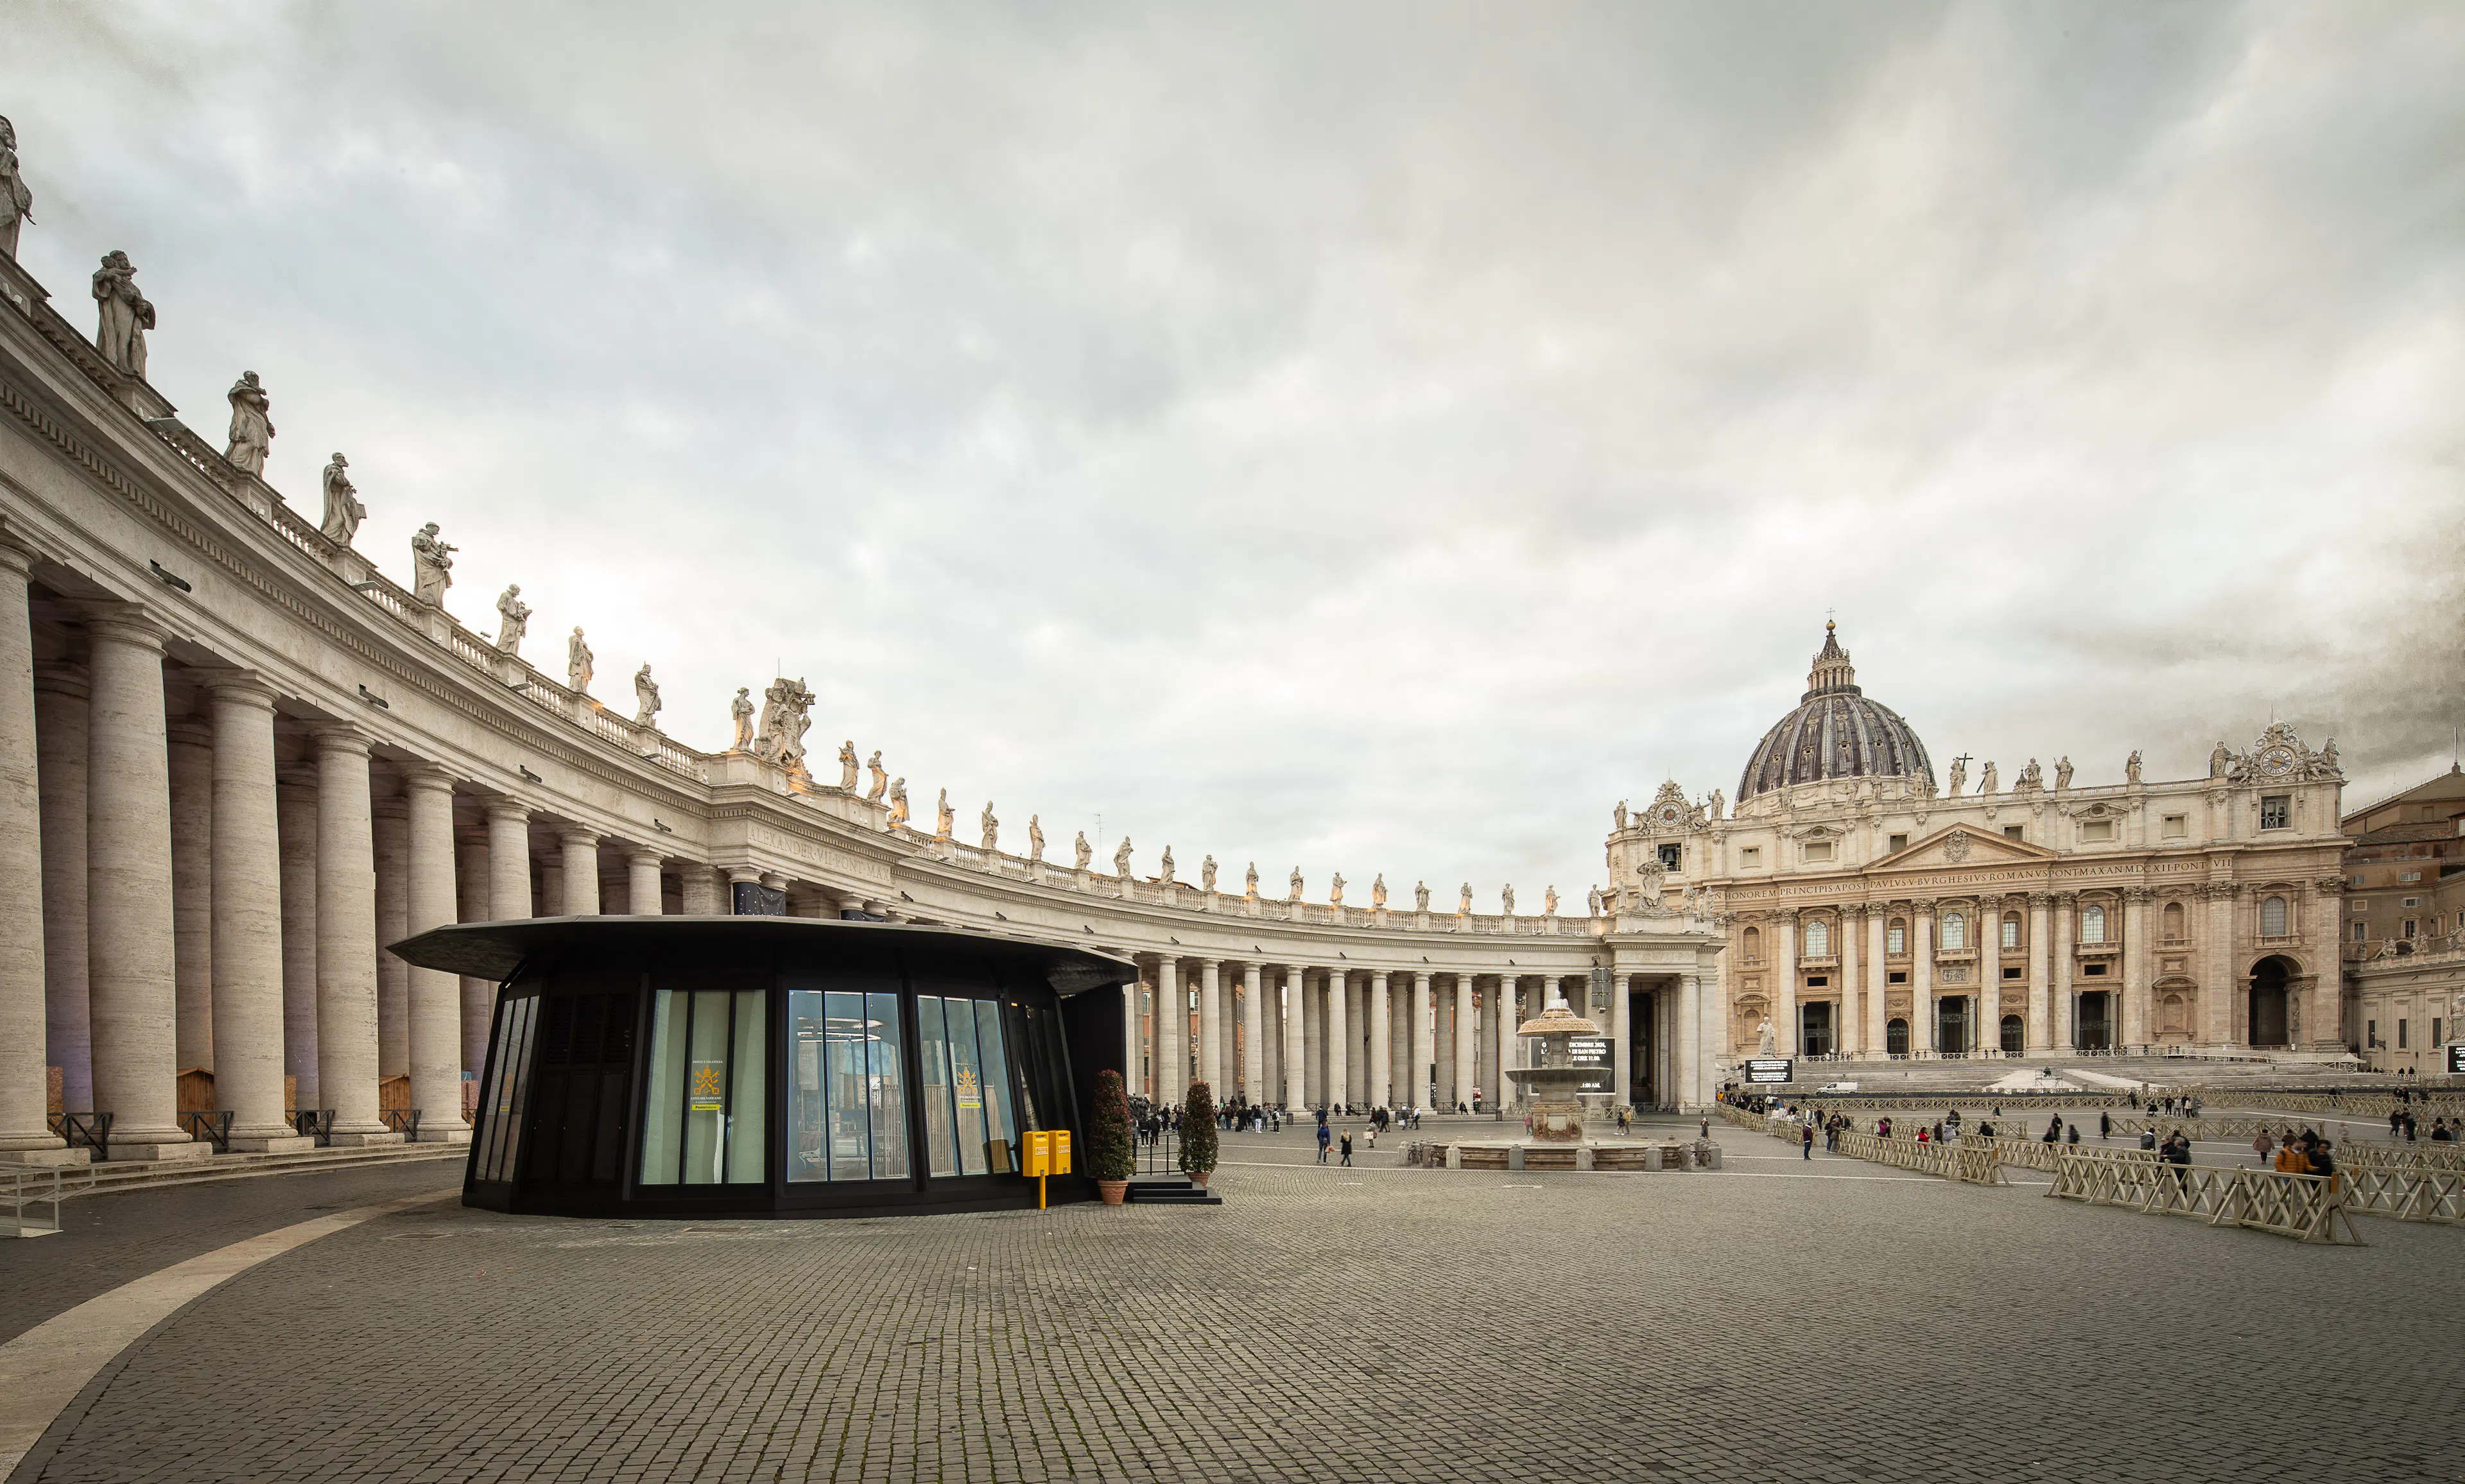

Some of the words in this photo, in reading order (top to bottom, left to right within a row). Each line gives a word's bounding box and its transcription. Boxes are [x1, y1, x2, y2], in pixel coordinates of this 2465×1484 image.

[749, 826, 815, 860] ALEXANDER
[817, 848, 832, 866] VII
[836, 854, 863, 874] PONT
[867, 863, 890, 881] MAX
[1725, 890, 1776, 900] HONOREM
[1780, 884, 1833, 896] PRINCIPIS
[1835, 882, 1867, 892] APOST
[1871, 880, 1906, 888] PAVLVS
[1917, 874, 1986, 886] BVRGHESIVS
[1989, 870, 2047, 881] ROMANVS
[2048, 869, 2079, 878] PONT
[2079, 867, 2104, 876] MAX
[2106, 866, 2122, 874] AN
[2125, 863, 2171, 873] MDCXII
[2174, 861, 2206, 871] PONT
[2213, 859, 2231, 867] VII
